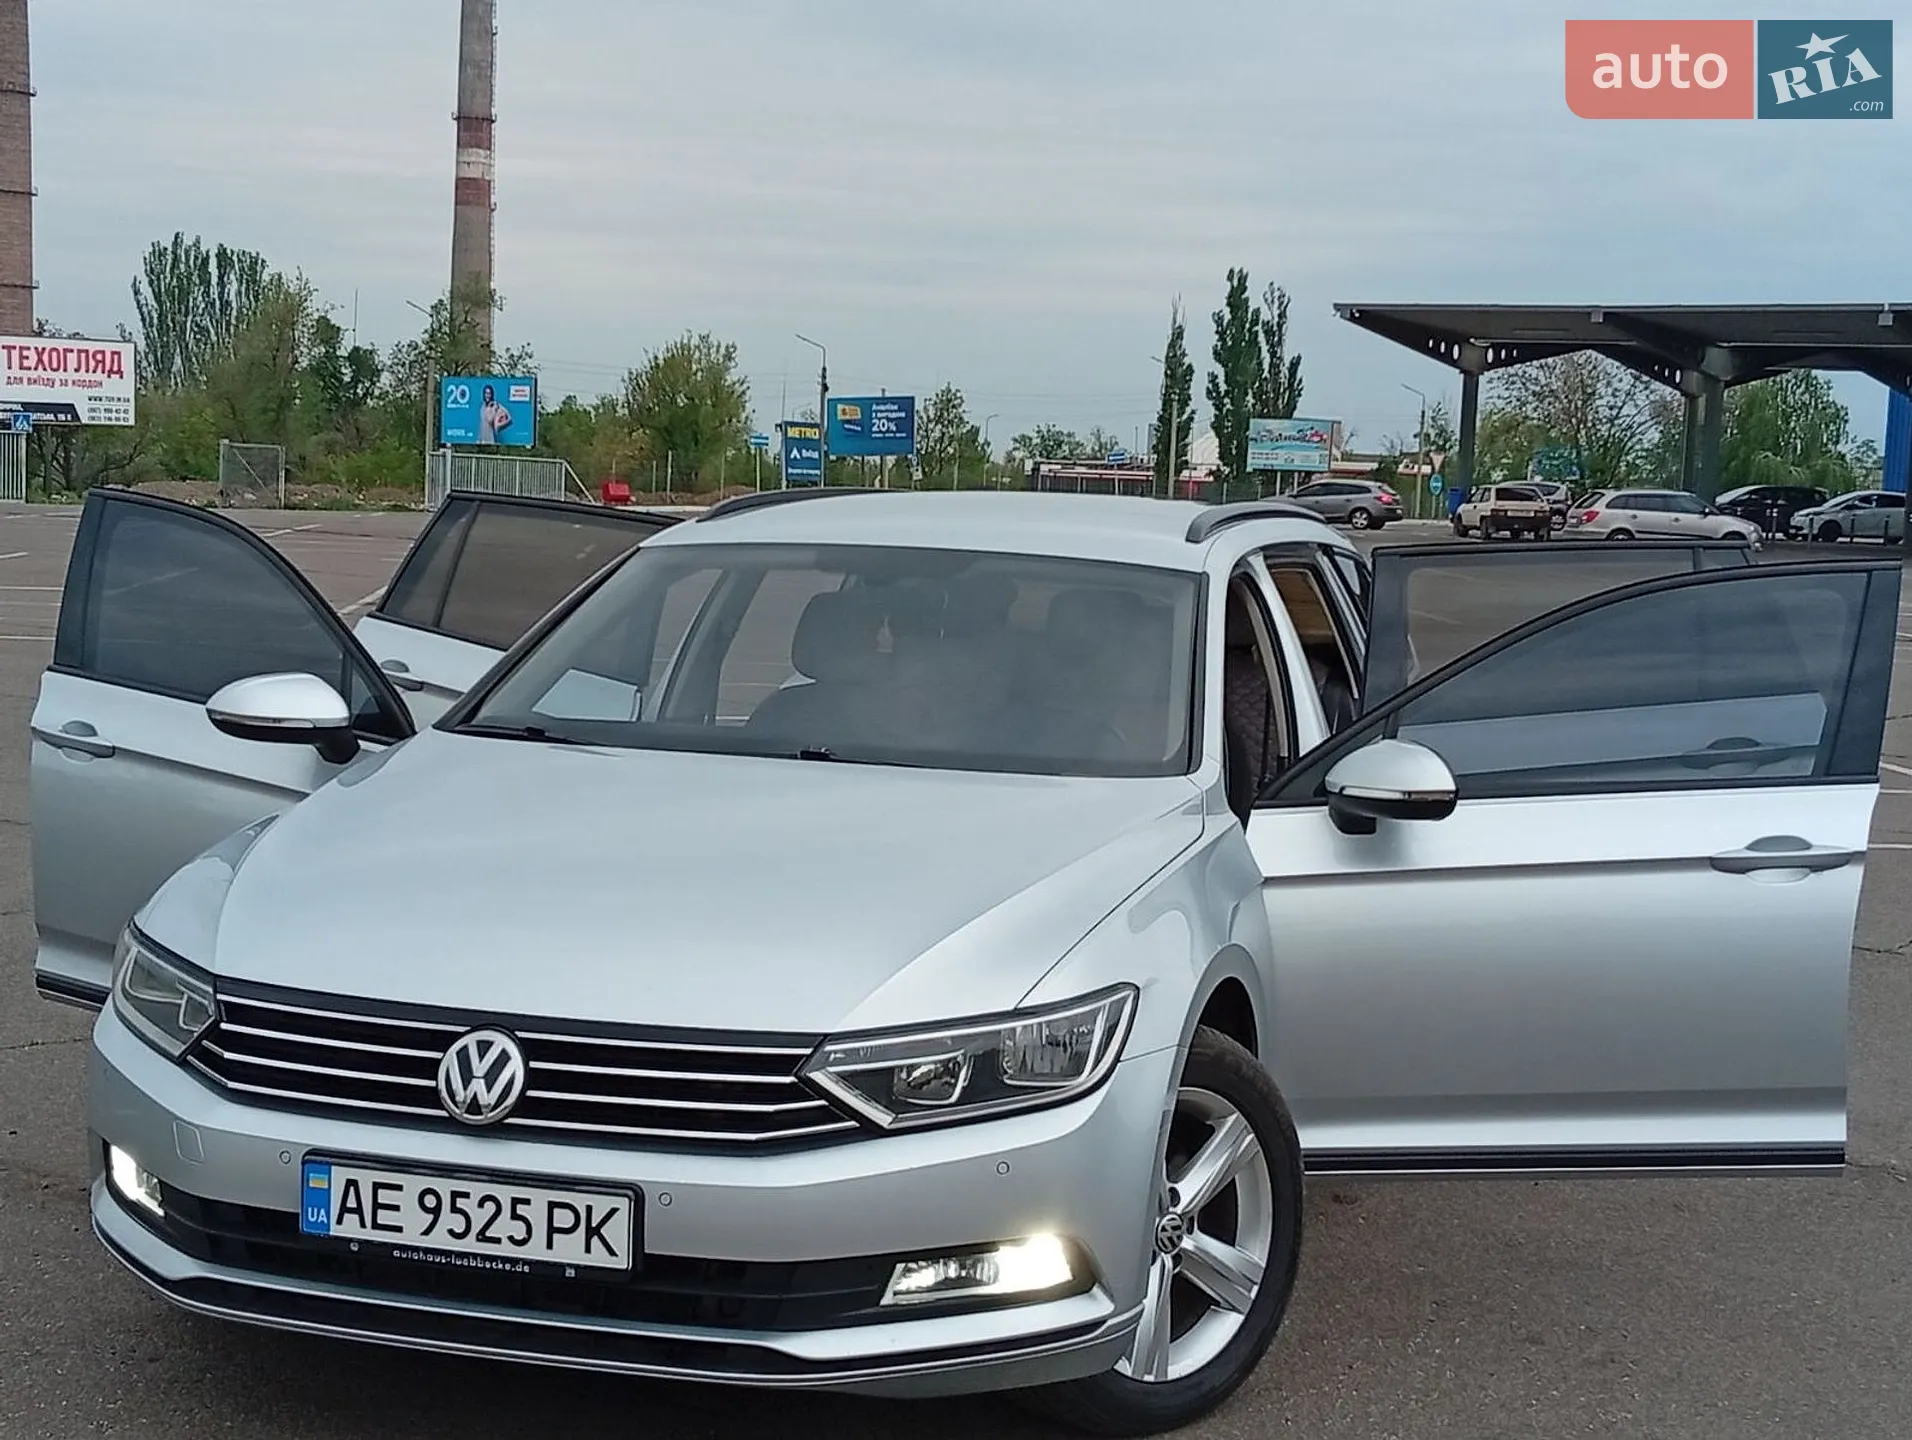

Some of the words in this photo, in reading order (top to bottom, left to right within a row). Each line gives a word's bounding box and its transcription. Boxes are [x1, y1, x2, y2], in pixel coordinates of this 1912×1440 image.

[2, 344, 124, 379] ТЕХОГЛЯД
[6, 376, 24, 386] для
[27, 375, 56, 388] виїзду
[60, 379, 69, 387] за
[72, 379, 103, 390] кордон
[447, 384, 470, 404] 20
[787, 426, 820, 439] METRO
[872, 419, 897, 432] 20%
[308, 1207, 328, 1224] UA
[335, 1178, 404, 1234] AE
[417, 1187, 533, 1247] 9525
[546, 1200, 621, 1258] PK
